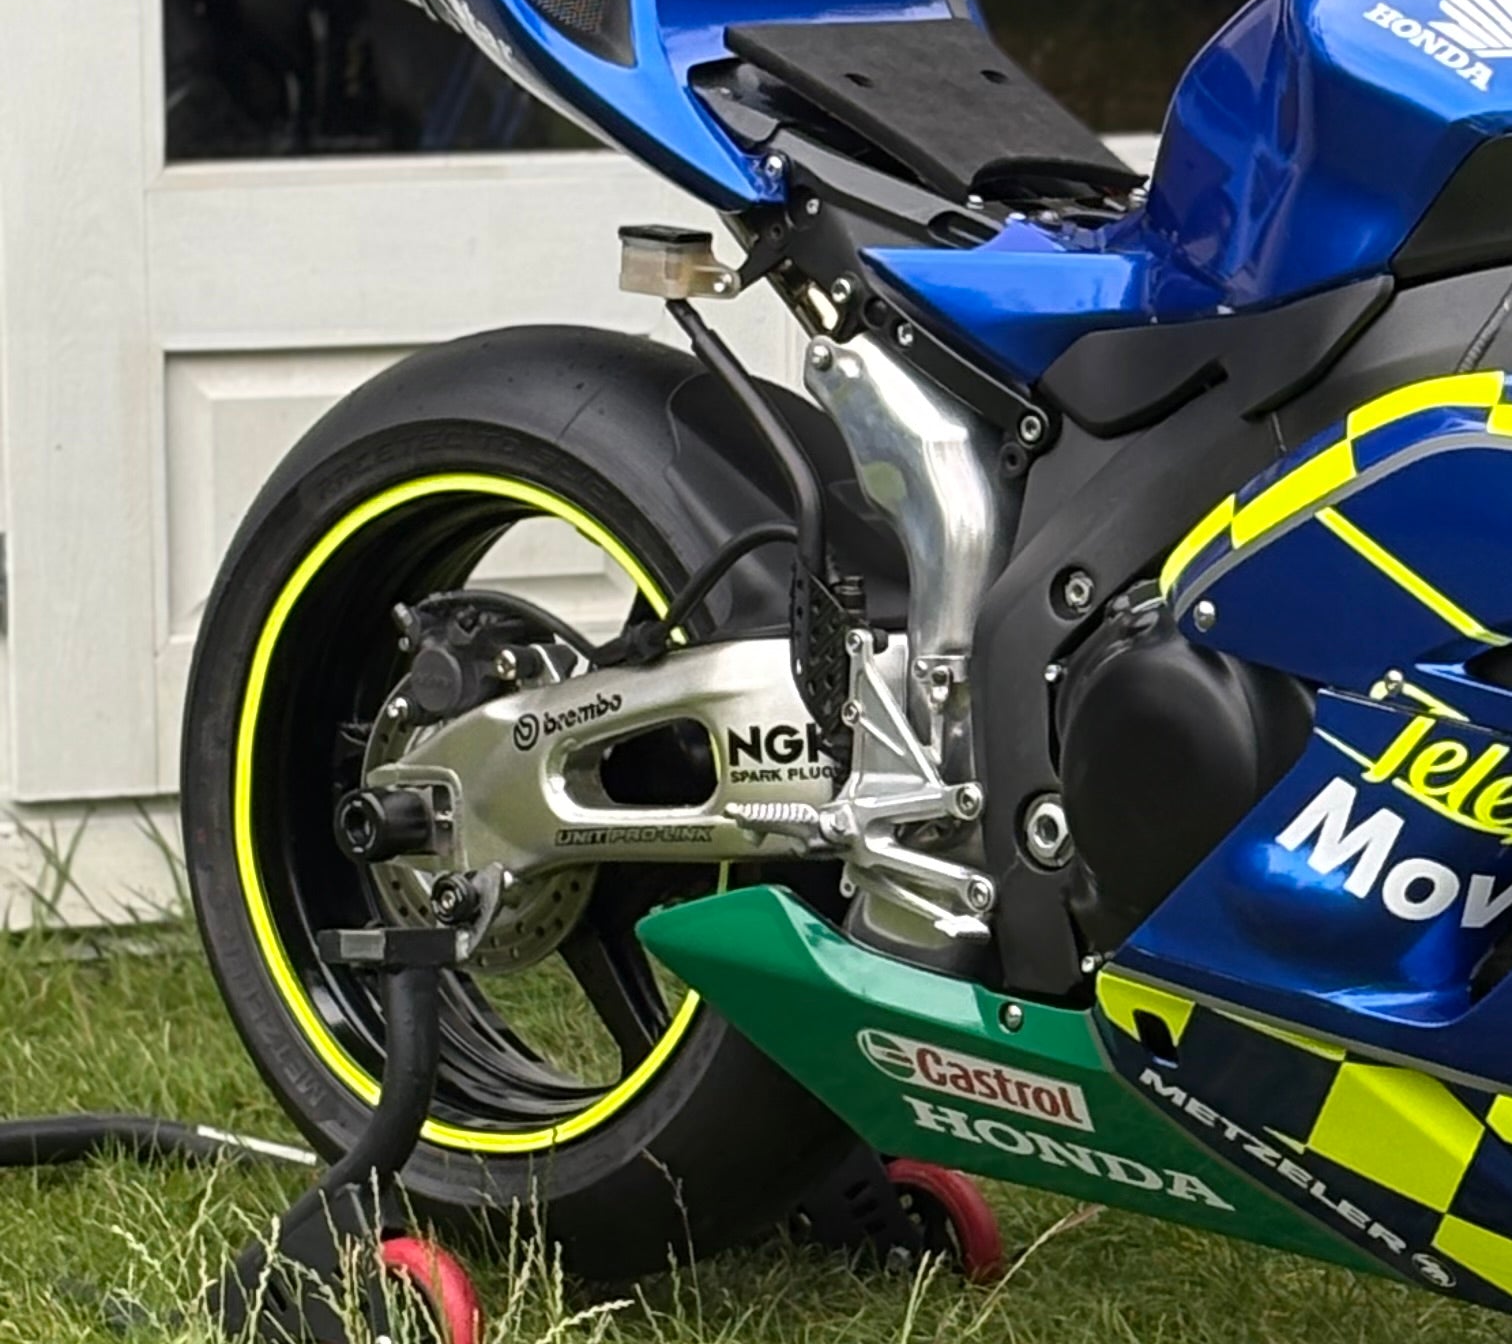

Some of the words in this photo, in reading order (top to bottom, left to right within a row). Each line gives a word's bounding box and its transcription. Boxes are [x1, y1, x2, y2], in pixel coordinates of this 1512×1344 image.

[1362, 2, 1494, 92] HONDA
[543, 692, 623, 736] brembo
[730, 767, 783, 784] SPARK
[916, 1047, 1083, 1124] Castrol
[902, 1094, 1236, 1212] HONDA
[1138, 1068, 1407, 1254] METZELER
